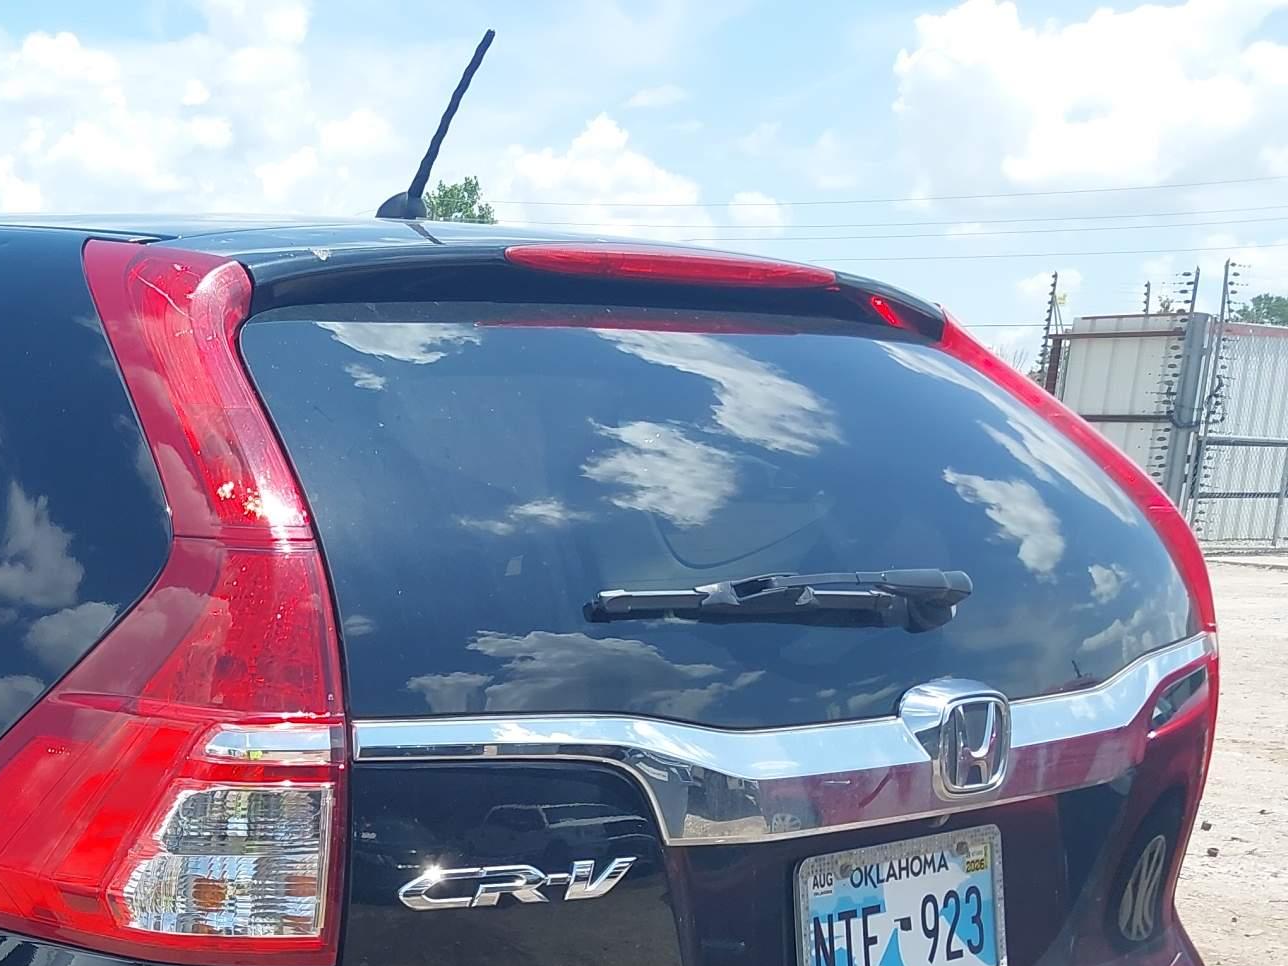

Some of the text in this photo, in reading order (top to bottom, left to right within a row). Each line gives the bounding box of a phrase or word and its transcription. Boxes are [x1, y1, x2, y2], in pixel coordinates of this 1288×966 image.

[398, 856, 638, 911] CR-V
[812, 872, 834, 890] AUG
[850, 851, 949, 889] OKLAHOMA
[921, 885, 985, 964] 923
